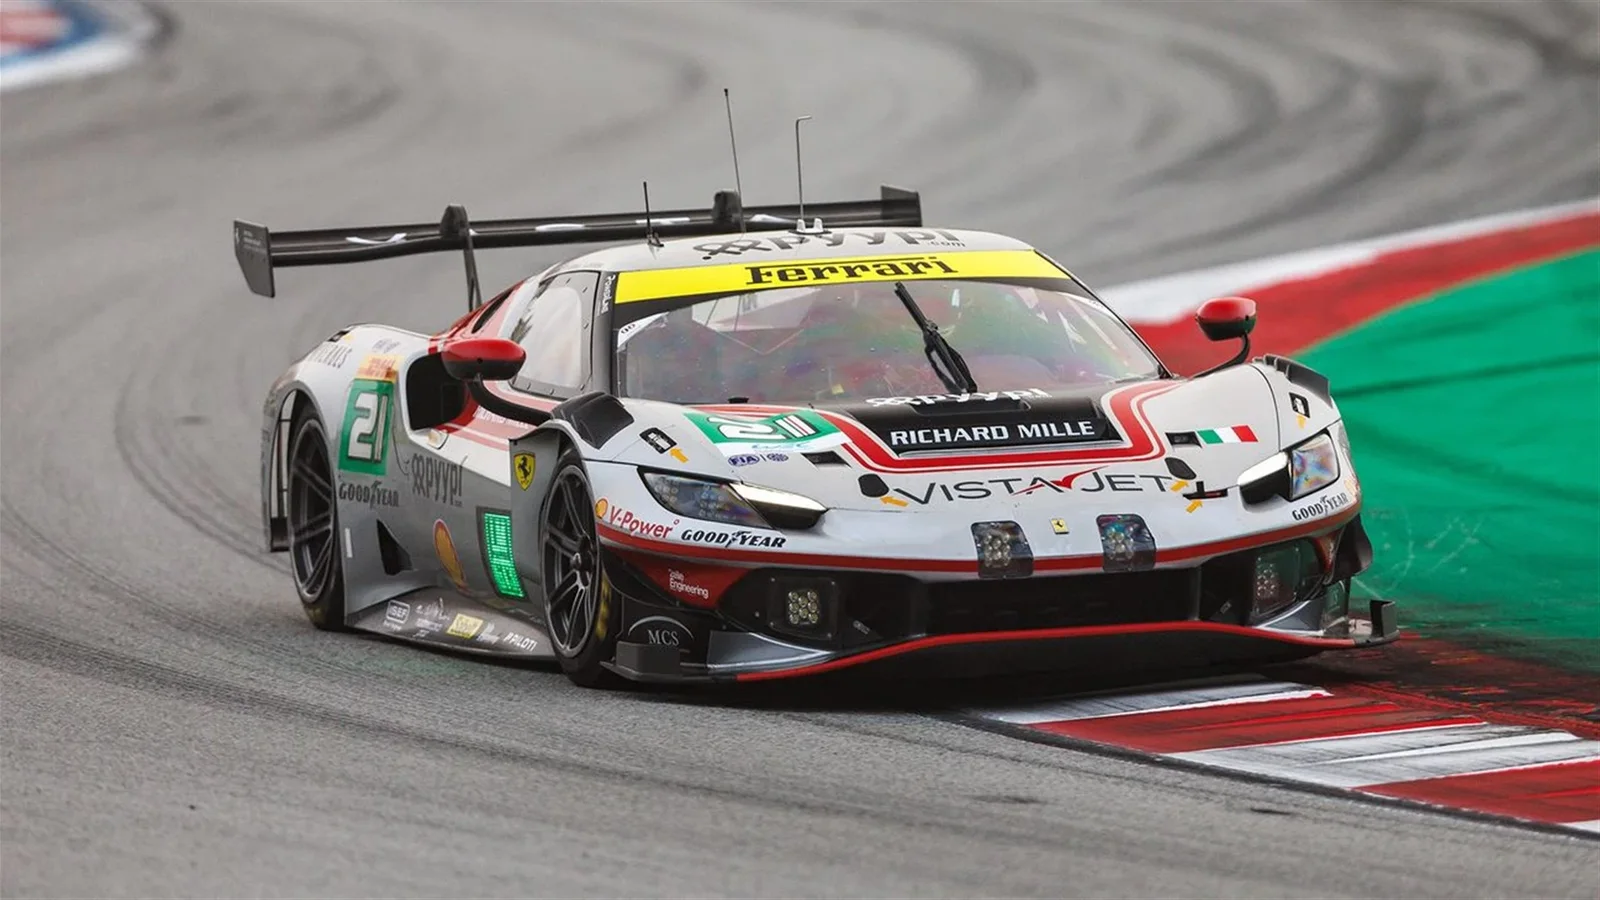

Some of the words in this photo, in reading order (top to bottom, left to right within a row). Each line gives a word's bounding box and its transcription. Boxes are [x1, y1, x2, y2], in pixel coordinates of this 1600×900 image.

[770, 231, 961, 250] pyypl
[746, 257, 958, 286] Ferrari
[915, 389, 1050, 405] pyypl
[347, 391, 389, 463] 21
[890, 425, 1010, 446] RICHARD
[1018, 421, 1096, 439] MILLE
[728, 454, 760, 466] FIA
[1292, 493, 1349, 521] GOODYEAR
[609, 506, 674, 539] V-Power
[681, 530, 787, 548] GOODYEAR
[669, 579, 709, 600] Engineering
[648, 629, 680, 647] MCS
